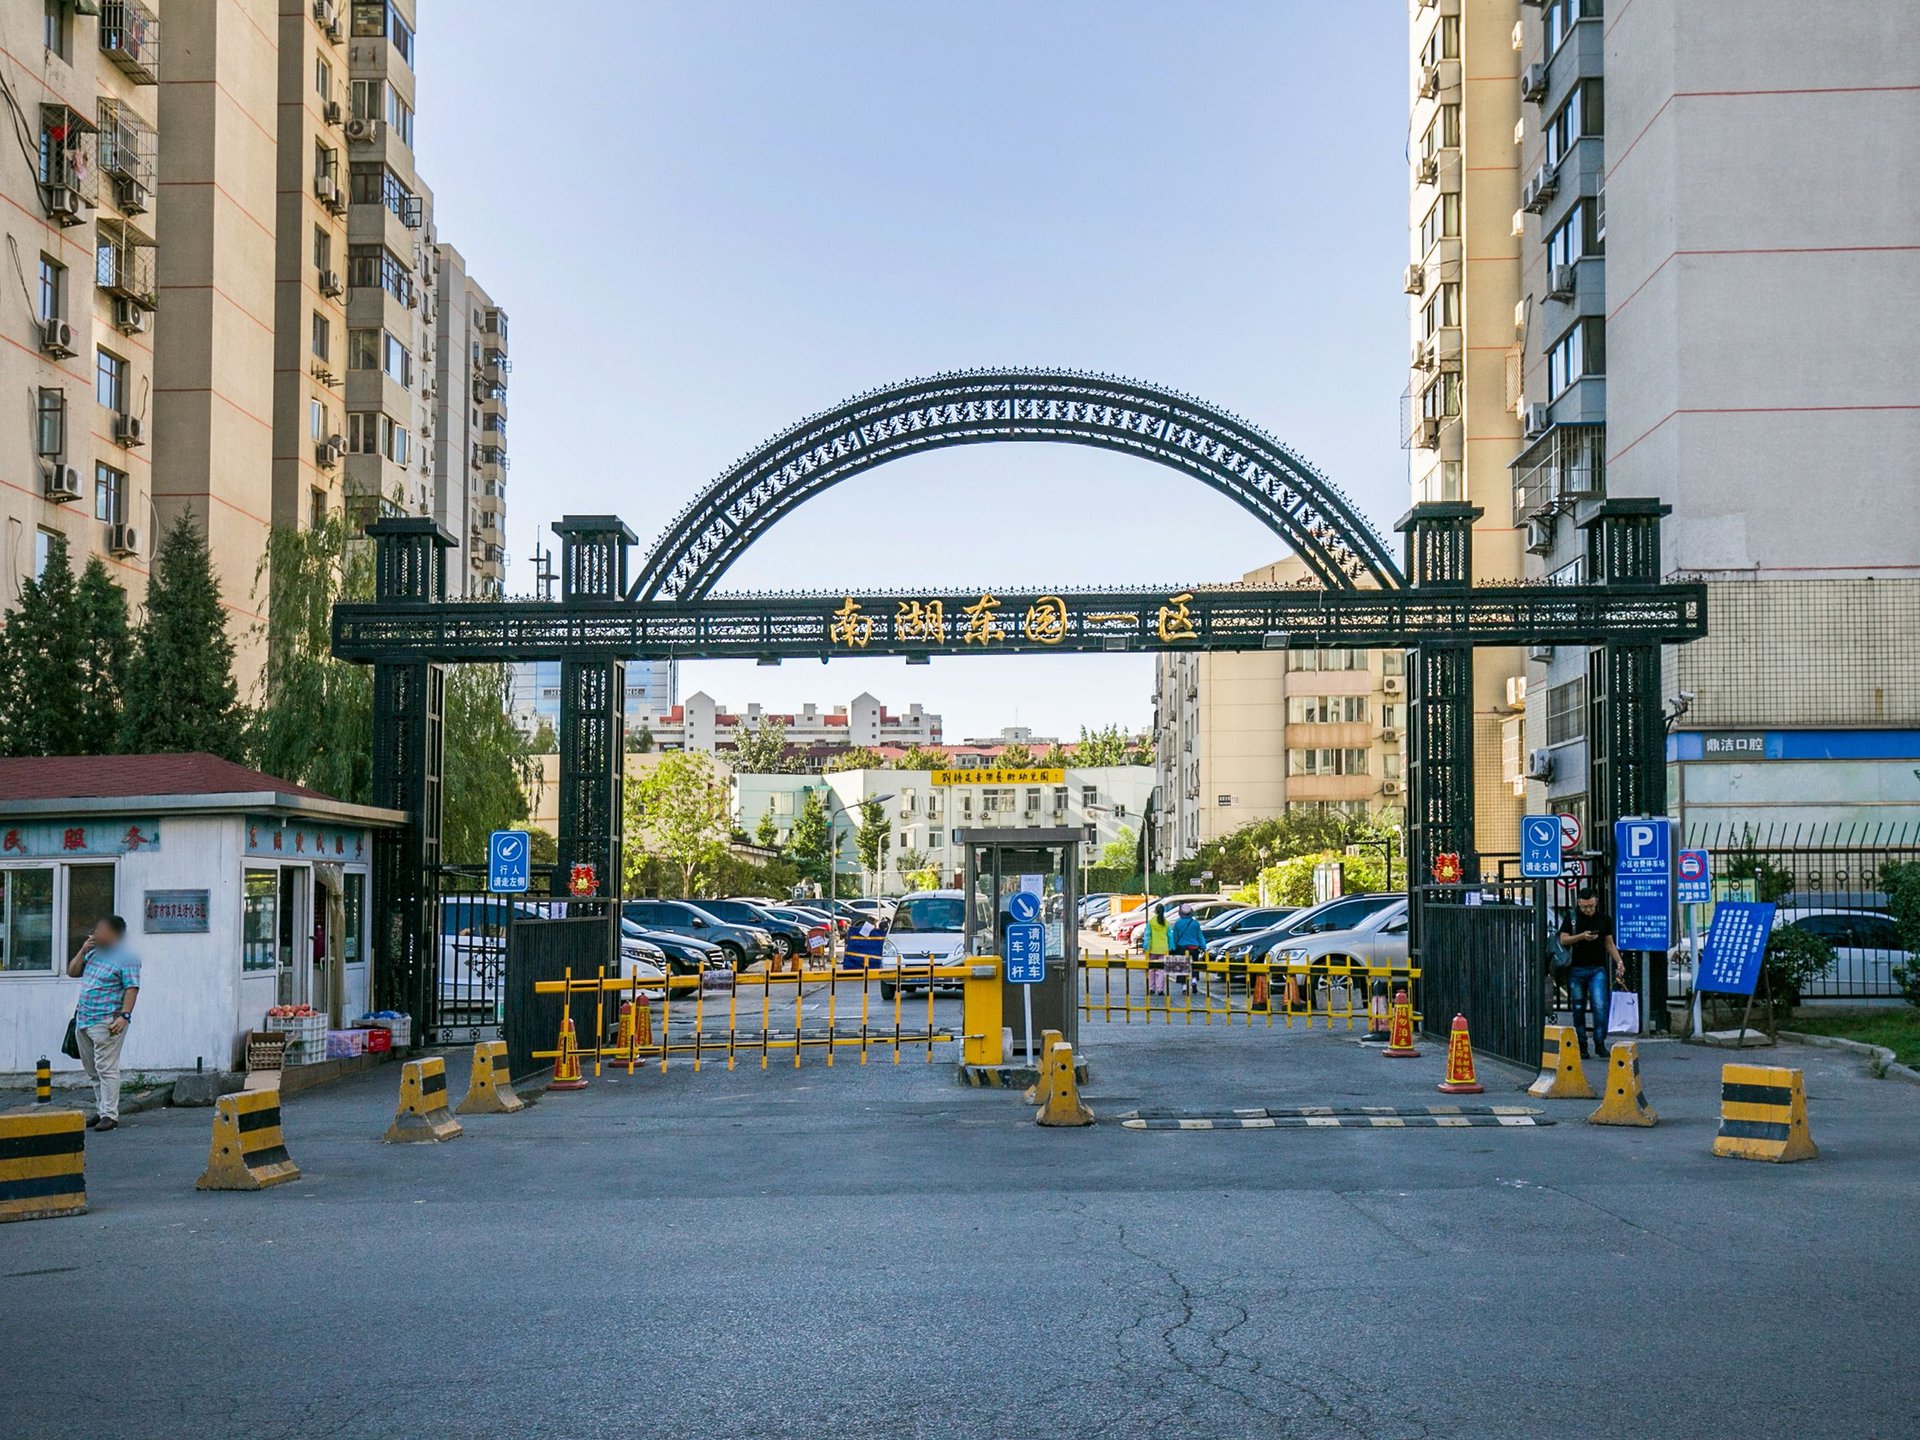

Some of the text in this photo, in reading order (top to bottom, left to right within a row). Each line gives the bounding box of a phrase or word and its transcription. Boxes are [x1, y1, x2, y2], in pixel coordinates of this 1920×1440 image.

[831, 594, 1197, 647] 南湖东园一区
[1706, 738, 1763, 752] 鼎洁口腔
[1631, 826, 1653, 856] P
[1531, 850, 1551, 859] 行人
[500, 865, 519, 875] 行人
[1525, 862, 1557, 872] 请走右侧
[494, 877, 525, 887] 请走左侧
[1011, 932, 1024, 977] 一车一杆
[1028, 928, 1040, 977] 请勿跟车
